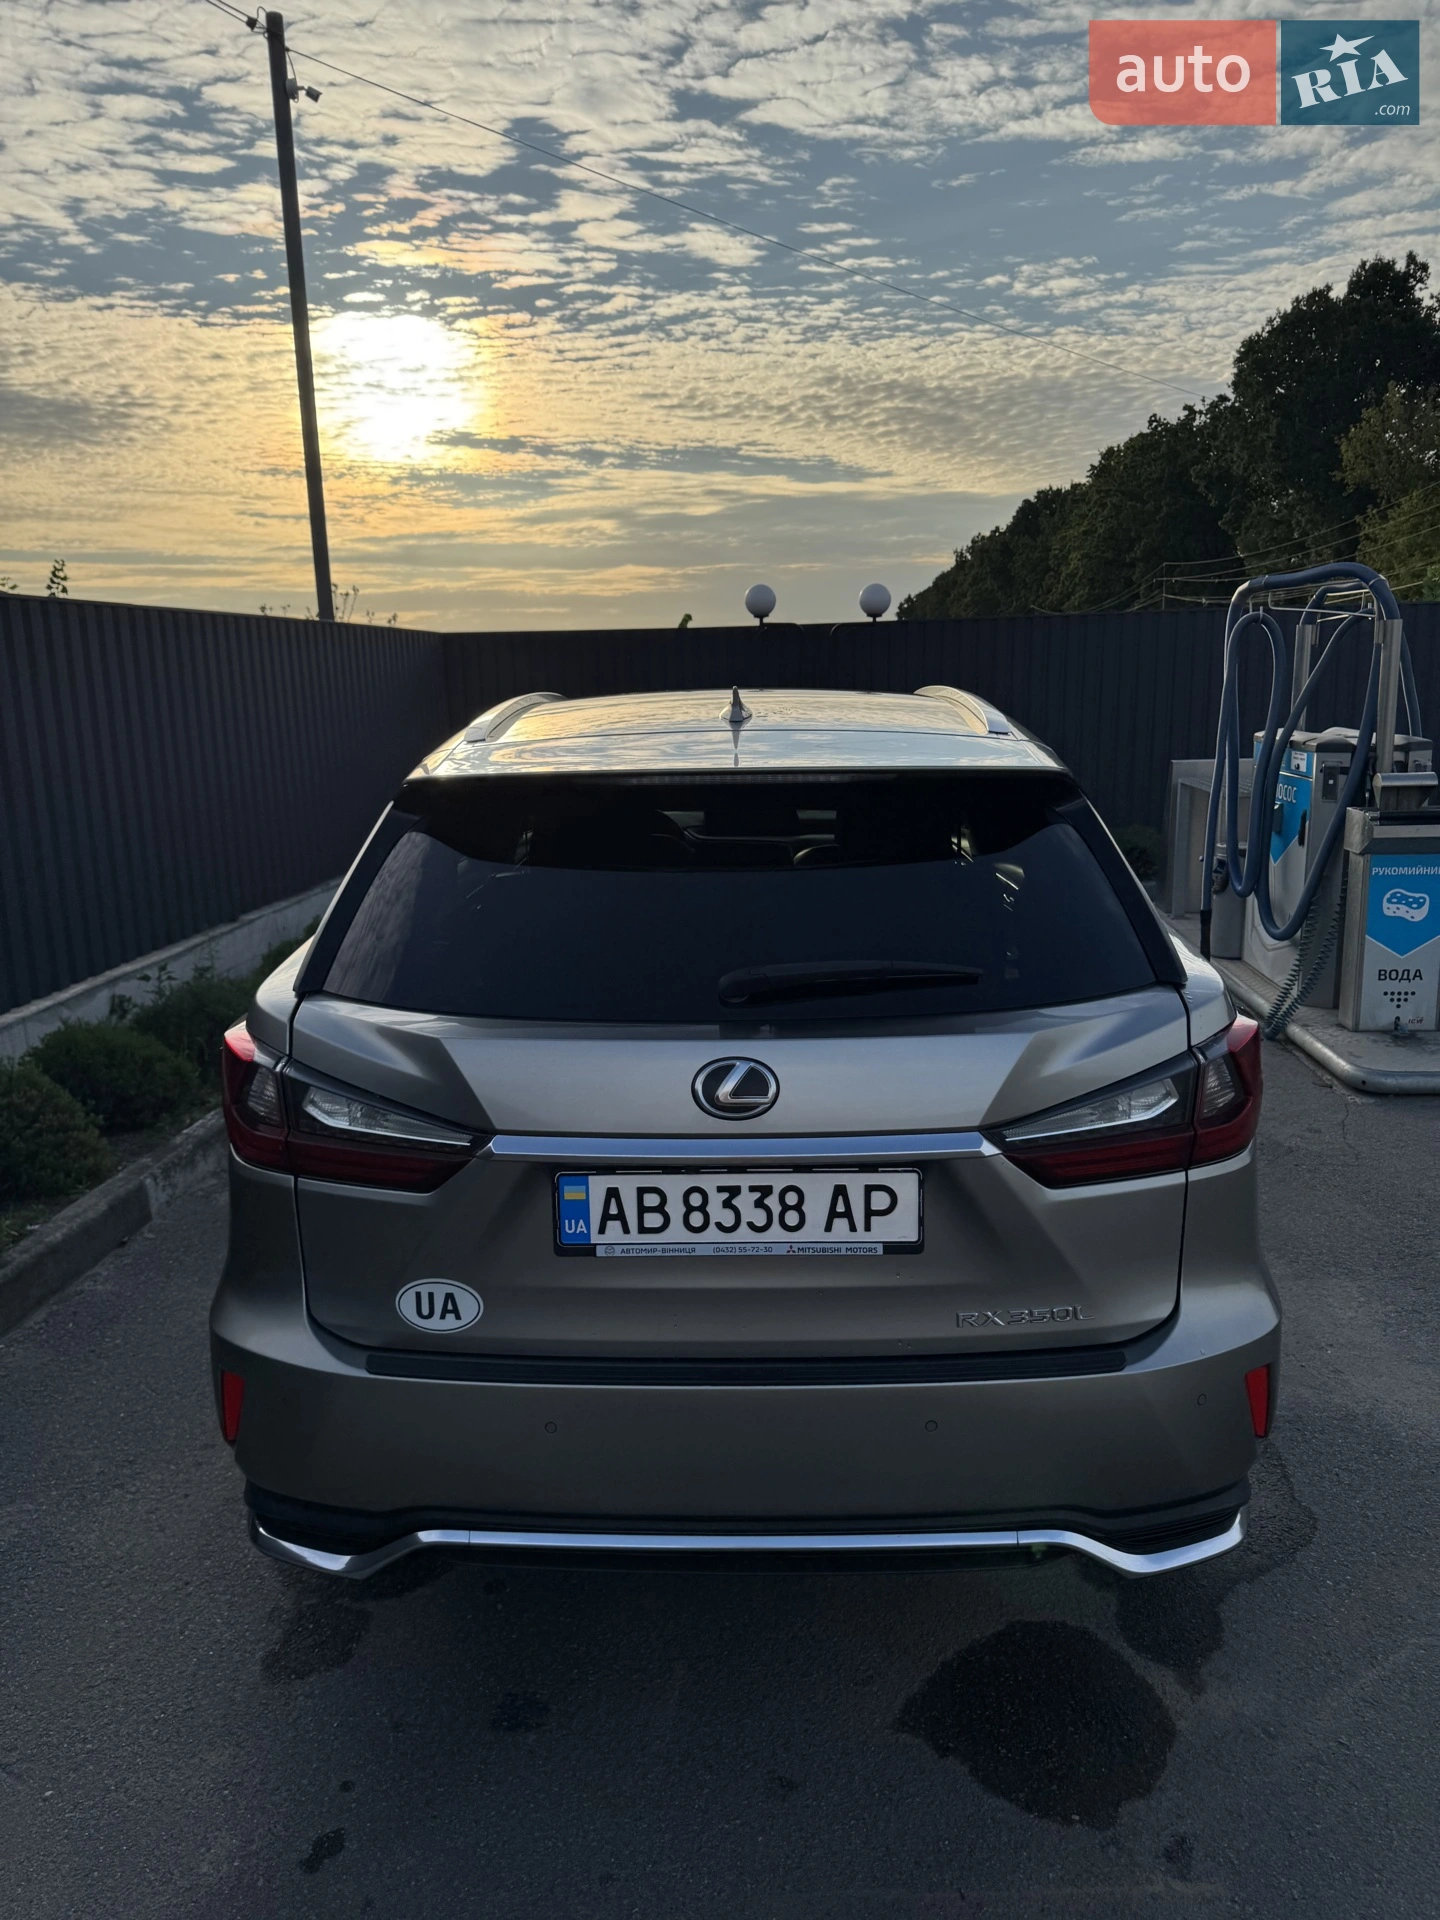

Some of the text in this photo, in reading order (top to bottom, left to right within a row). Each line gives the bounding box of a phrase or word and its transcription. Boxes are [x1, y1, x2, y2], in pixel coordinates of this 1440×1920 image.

[1372, 865, 1440, 876] РУКОМИЙНИ
[1378, 969, 1423, 983] ВОДА
[598, 1184, 898, 1235] AB 8338 AP
[564, 1219, 588, 1234] UA
[712, 1246, 737, 1254] (0432)
[797, 1246, 842, 1254] MITSUBISHI
[845, 1246, 878, 1254] MOTORS
[415, 1291, 462, 1320] UA
